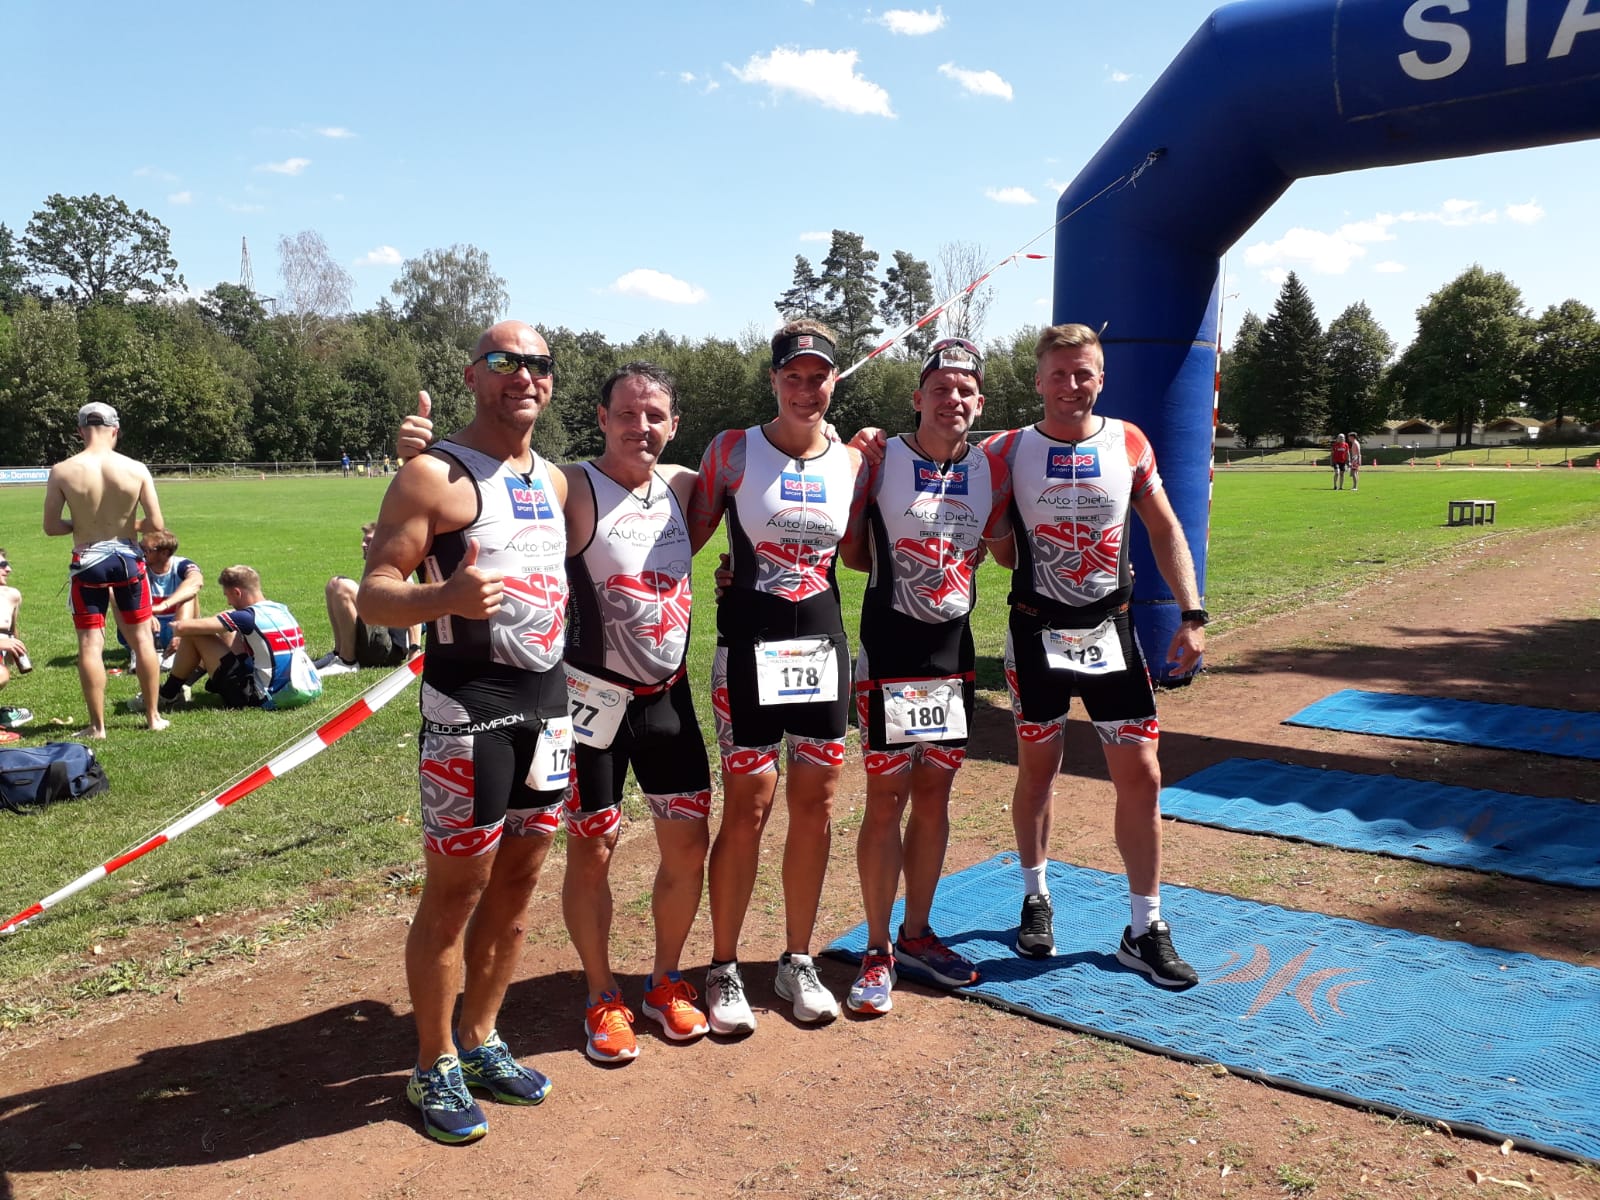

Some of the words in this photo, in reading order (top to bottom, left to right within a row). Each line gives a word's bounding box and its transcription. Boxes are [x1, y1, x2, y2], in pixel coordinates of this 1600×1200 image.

[1052, 454, 1096, 467] KAPS
[784, 479, 822, 493] KAPS
[512, 488, 546, 504] KAPS
[1064, 645, 1102, 665] 179
[780, 666, 819, 688] 178
[907, 705, 945, 728] 180
